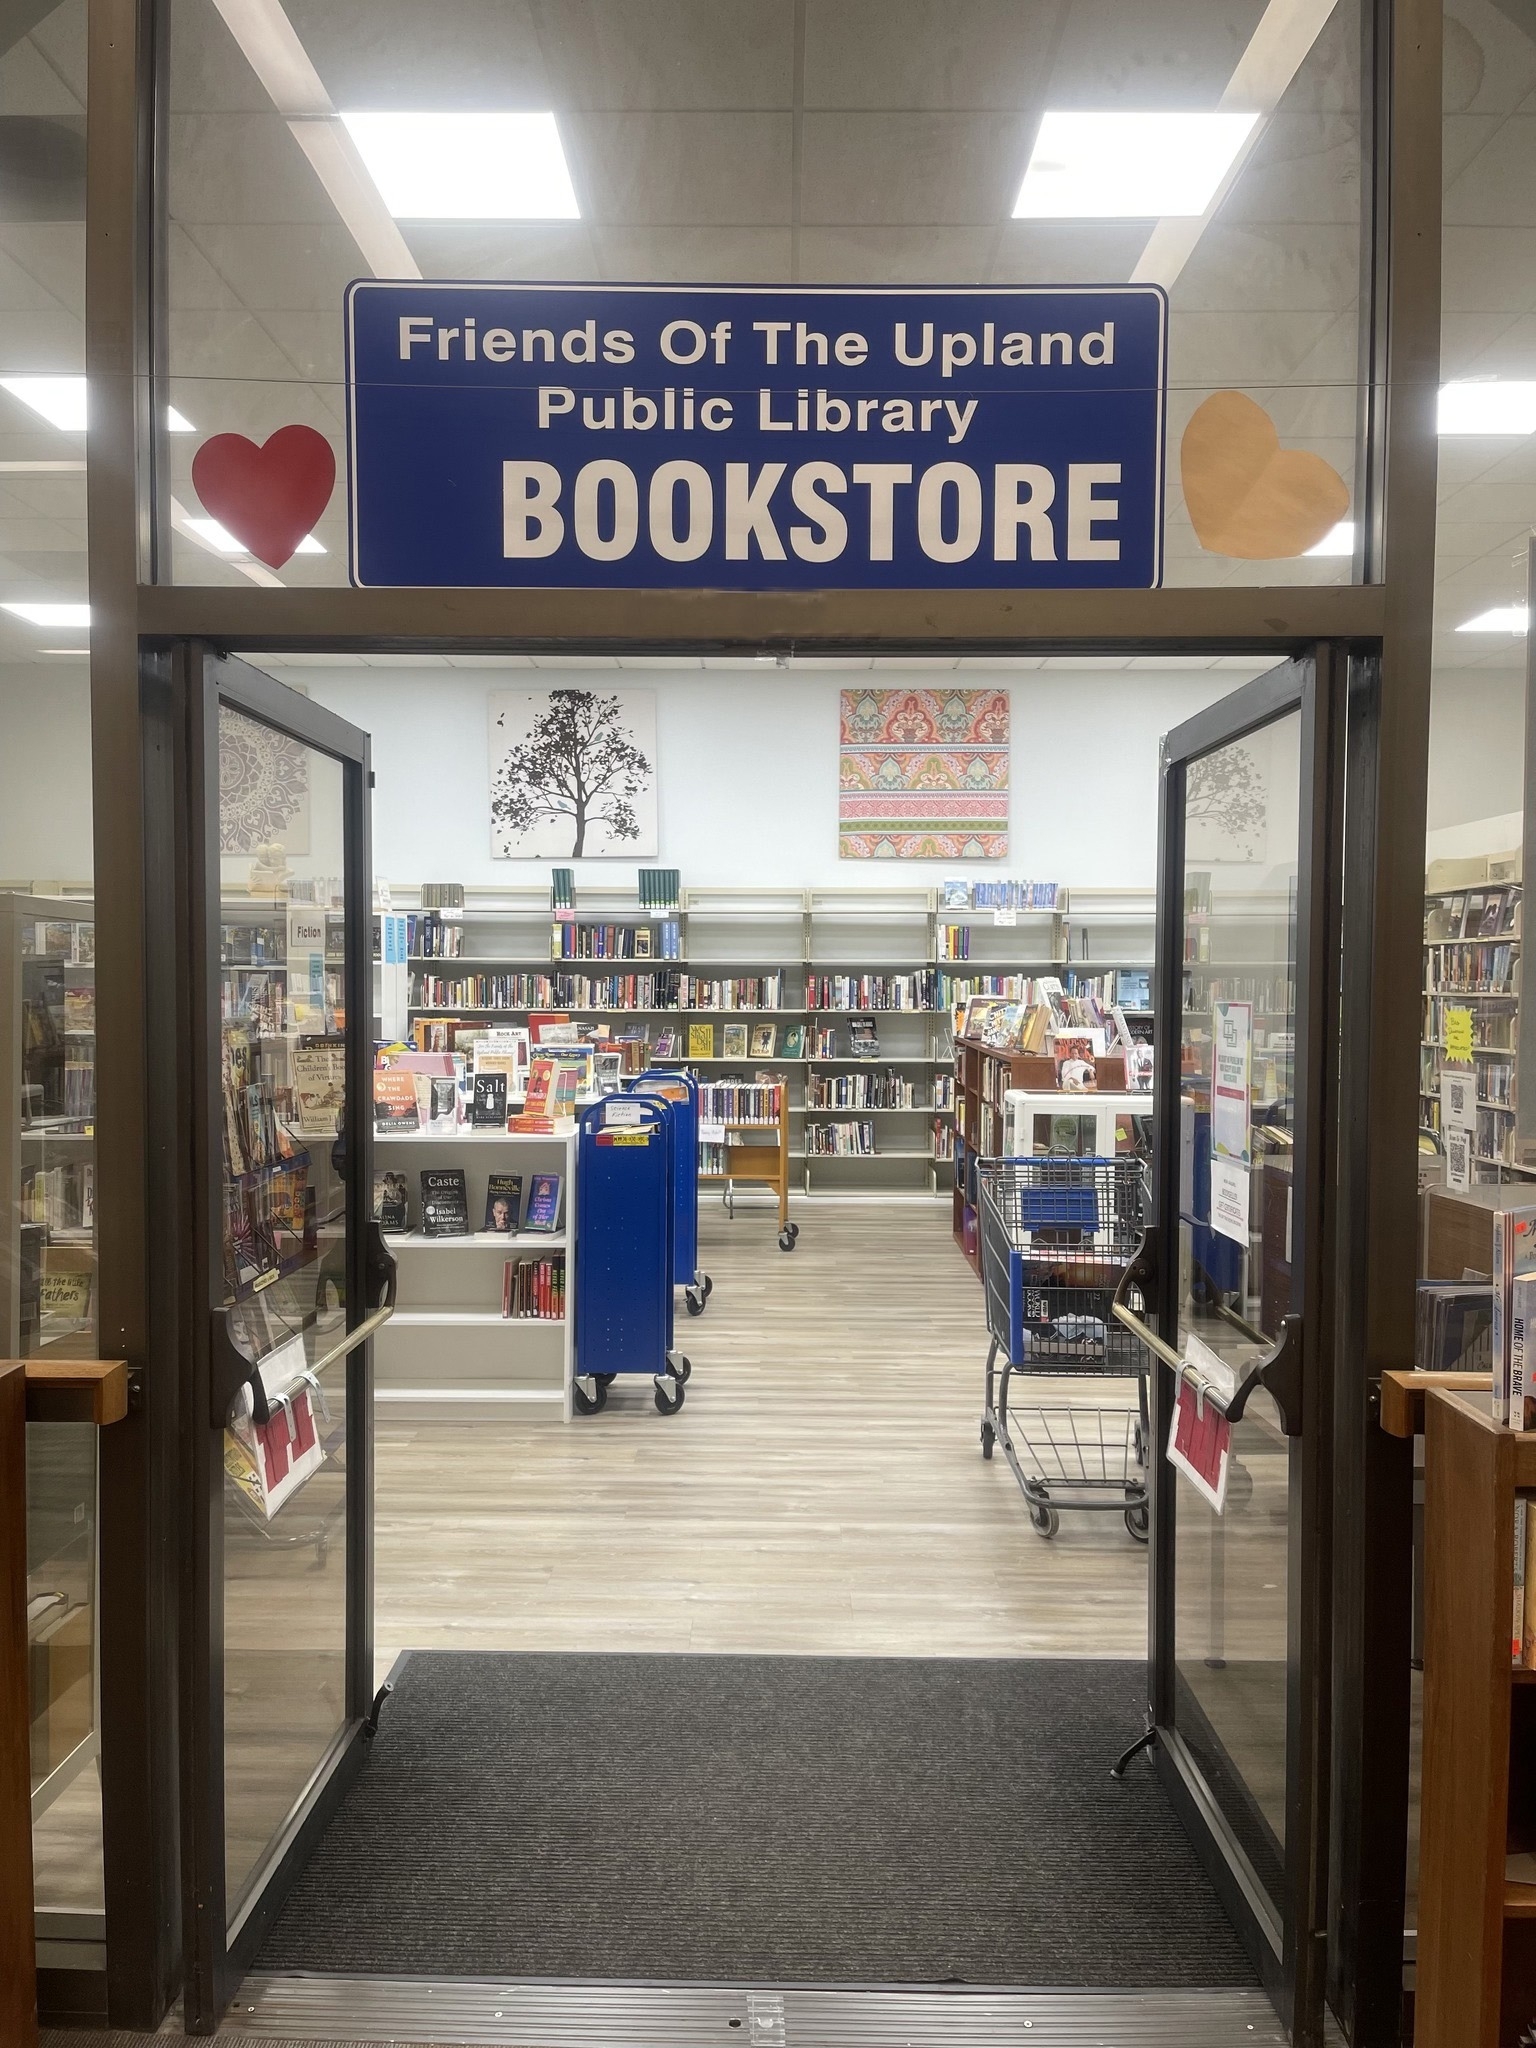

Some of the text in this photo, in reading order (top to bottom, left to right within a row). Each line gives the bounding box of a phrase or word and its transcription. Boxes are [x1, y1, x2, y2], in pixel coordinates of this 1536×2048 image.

[399, 316, 1115, 377] Friends Of The Upland
[537, 386, 979, 444] Public Library
[502, 459, 1122, 563] BOOKSTORE
[297, 926, 321, 938] Fiction
[333, 1064, 346, 1072] Boo
[476, 1079, 505, 1093] Salt
[428, 1176, 459, 1187] Caste
[53, 1277, 66, 1286] the
[1512, 1317, 1524, 1396] HOME OF THE BRAVE
